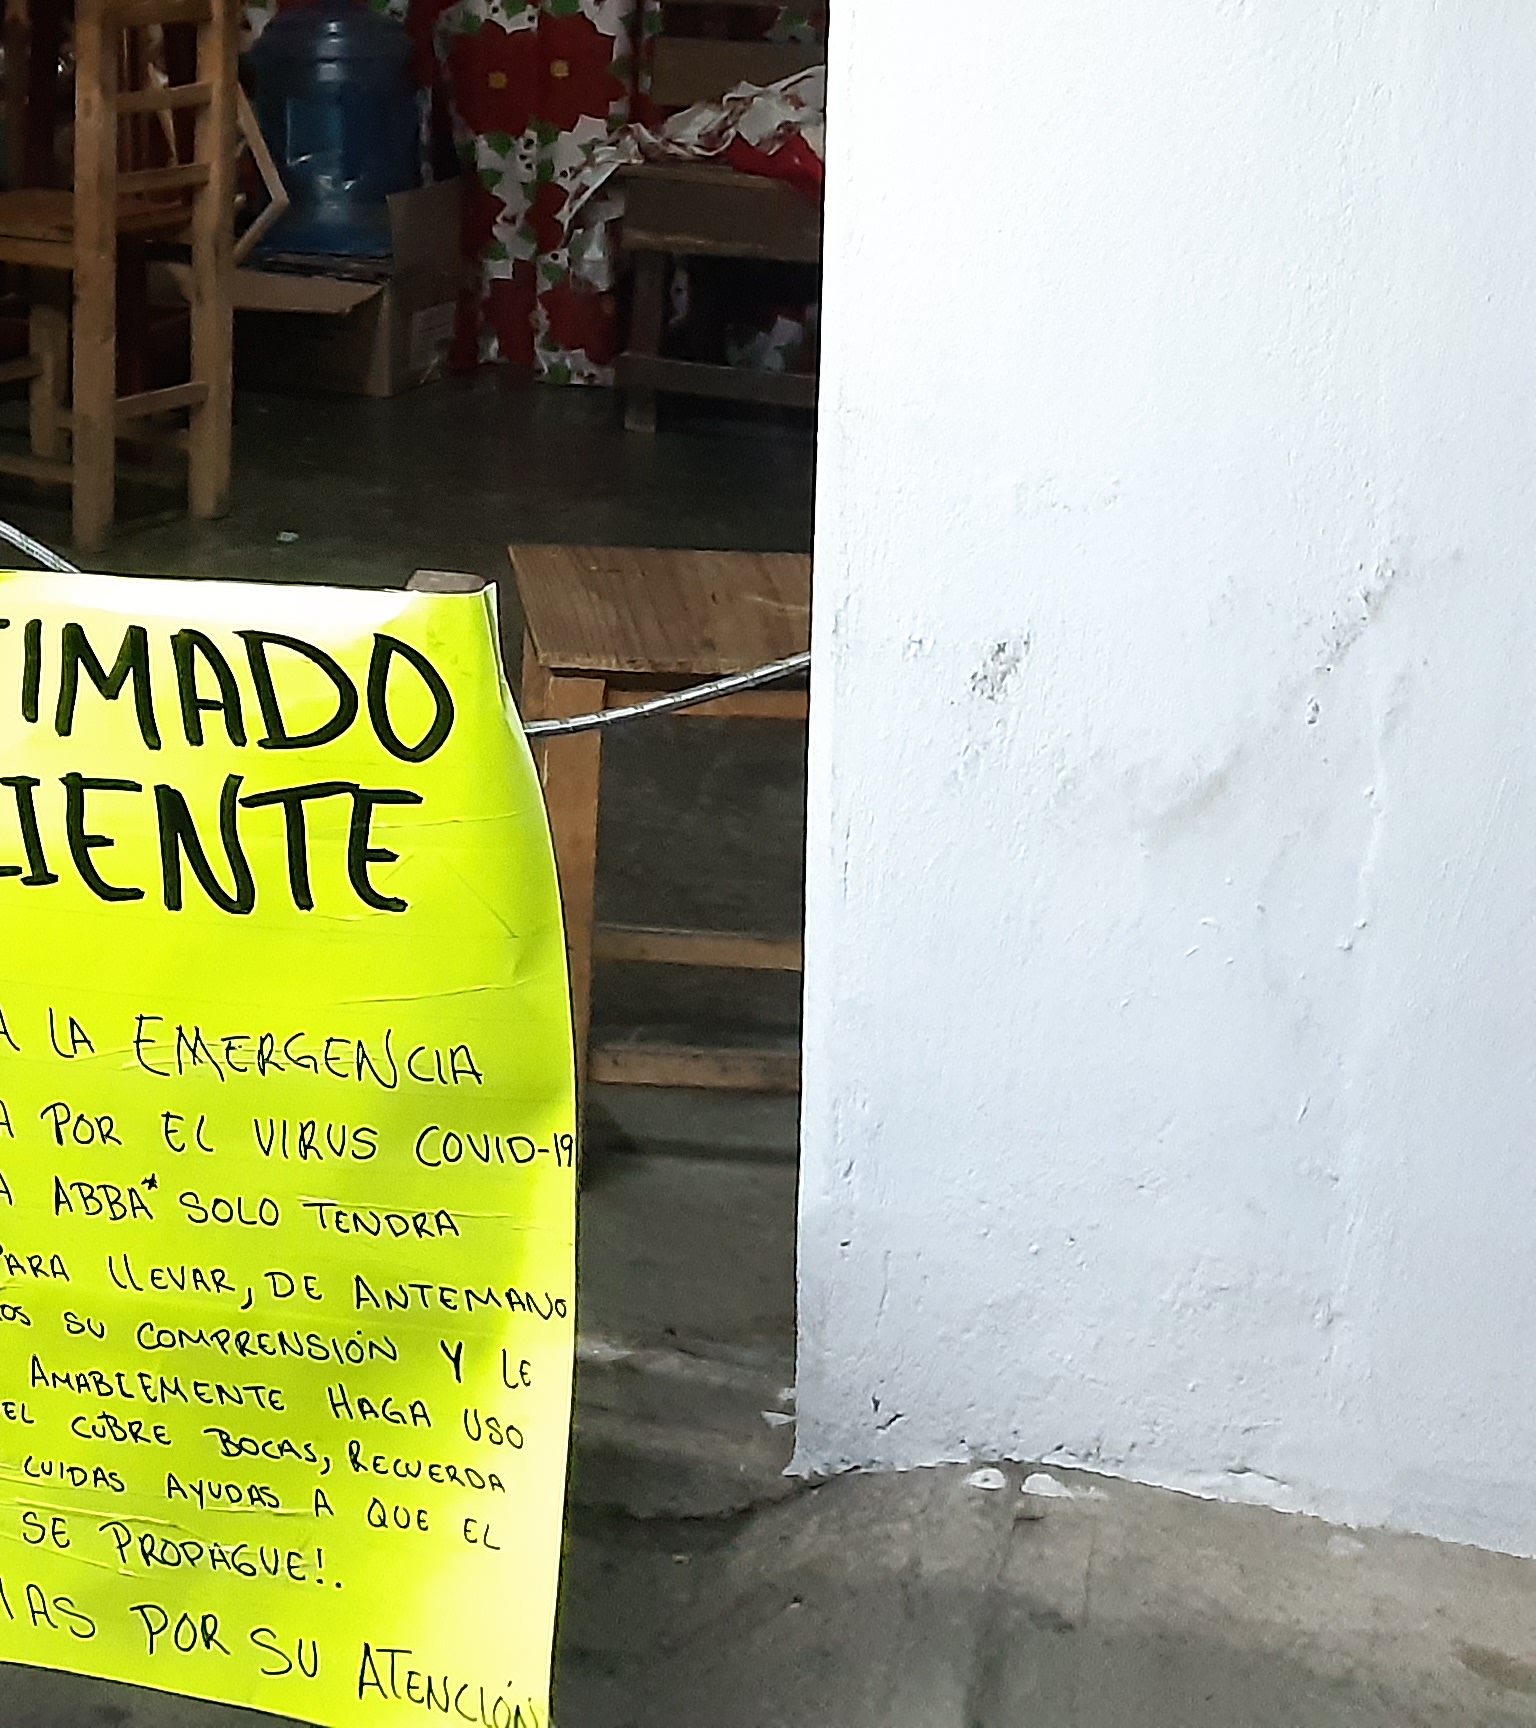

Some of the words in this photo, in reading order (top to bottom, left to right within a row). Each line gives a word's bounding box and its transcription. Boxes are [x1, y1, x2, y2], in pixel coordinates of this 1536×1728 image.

[48, 1007, 95, 1059] LA
[132, 1013, 483, 1089] EMERGENCIA
[40, 1102, 123, 1147] POR
[160, 1110, 214, 1153] EL
[253, 1118, 378, 1161] VIRUS
[415, 1125, 574, 1168] COVID-19
[179, 1191, 279, 1227] SOLO
[302, 1202, 460, 1239] TENDRA
[264, 1271, 323, 1301] DE
[354, 1274, 567, 1321] ANTEMANO
[63, 1311, 105, 1339] SU
[136, 1322, 397, 1365] COMPRENSIÓN
[440, 1339, 463, 1384] Y
[501, 1348, 531, 1390] LE
[31, 1355, 285, 1411] AMABLEMENTE
[327, 1382, 432, 1428] HAGA
[463, 1408, 524, 1450] USO
[203, 1427, 331, 1476] BOCAS,
[348, 1439, 506, 1493] RECUERDA
[22, 1511, 71, 1549] SE
[23, 1455, 125, 1493] CUIDAS
[167, 1472, 281, 1511] AYUDAS
[314, 1488, 334, 1517] A
[367, 1496, 429, 1532] QUE
[463, 1517, 501, 1551] EL
[129, 1604, 231, 1656] POR
[250, 1627, 318, 1678] SU
